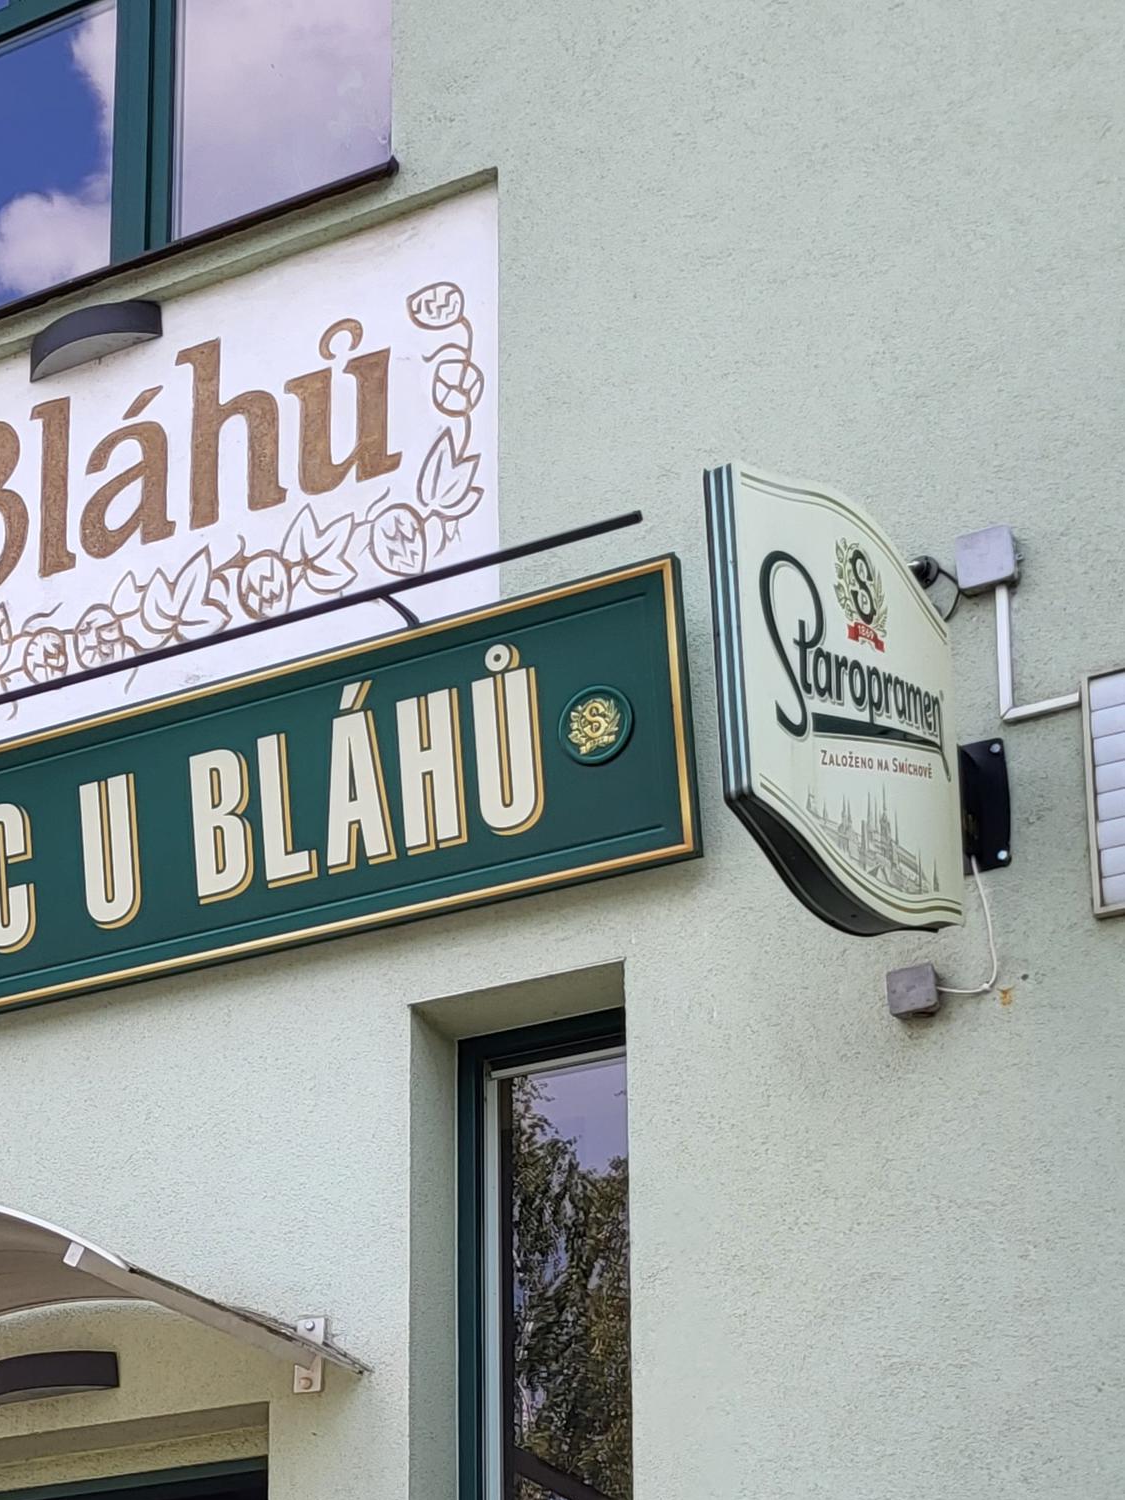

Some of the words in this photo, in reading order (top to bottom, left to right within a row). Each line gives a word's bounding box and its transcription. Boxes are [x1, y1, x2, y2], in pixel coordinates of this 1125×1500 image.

[79, 772, 142, 931] U
[188, 642, 545, 906] BLÁHŮ
[760, 550, 951, 782] Staropramen
